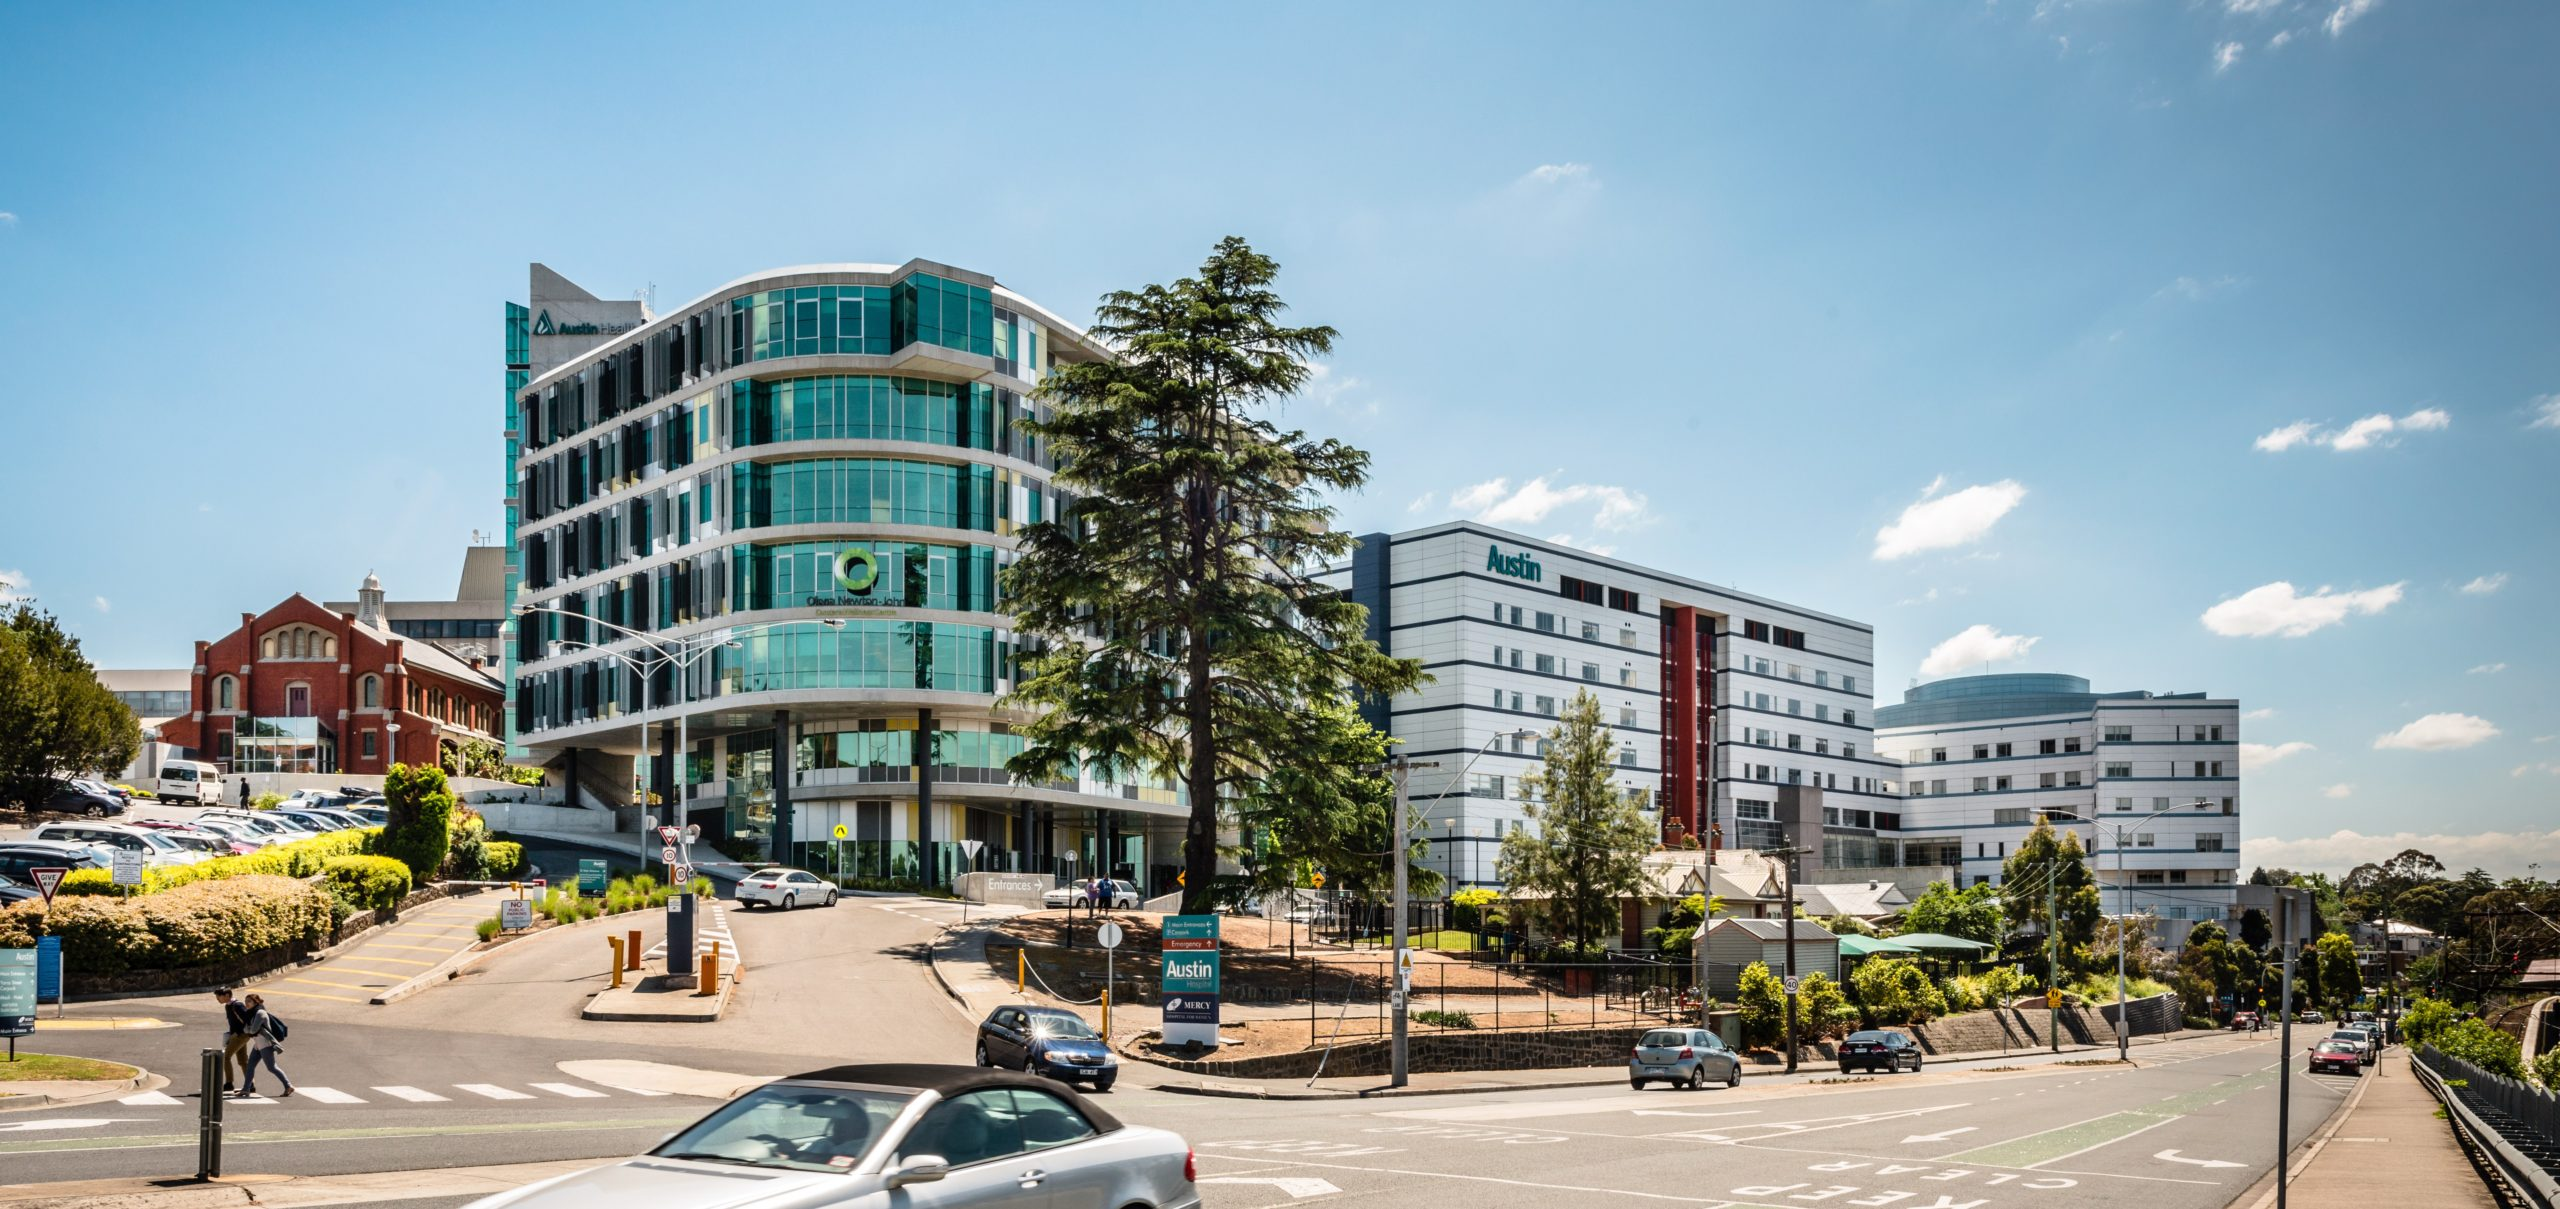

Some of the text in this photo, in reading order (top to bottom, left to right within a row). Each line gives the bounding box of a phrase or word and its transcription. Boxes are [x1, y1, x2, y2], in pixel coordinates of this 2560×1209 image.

[559, 322, 599, 335] Austin
[1486, 544, 1542, 583] Austin
[988, 878, 1032, 891] Entrances
[1171, 940, 1203, 949] Emergency
[16, 952, 35, 961] Austin
[1166, 959, 1212, 978] Austin
[1786, 981, 1797, 989] 40
[1184, 1001, 1212, 1010] MERCY
[1807, 1160, 2079, 1190] CLEAR
[1730, 1183, 1991, 1209] KEEP
